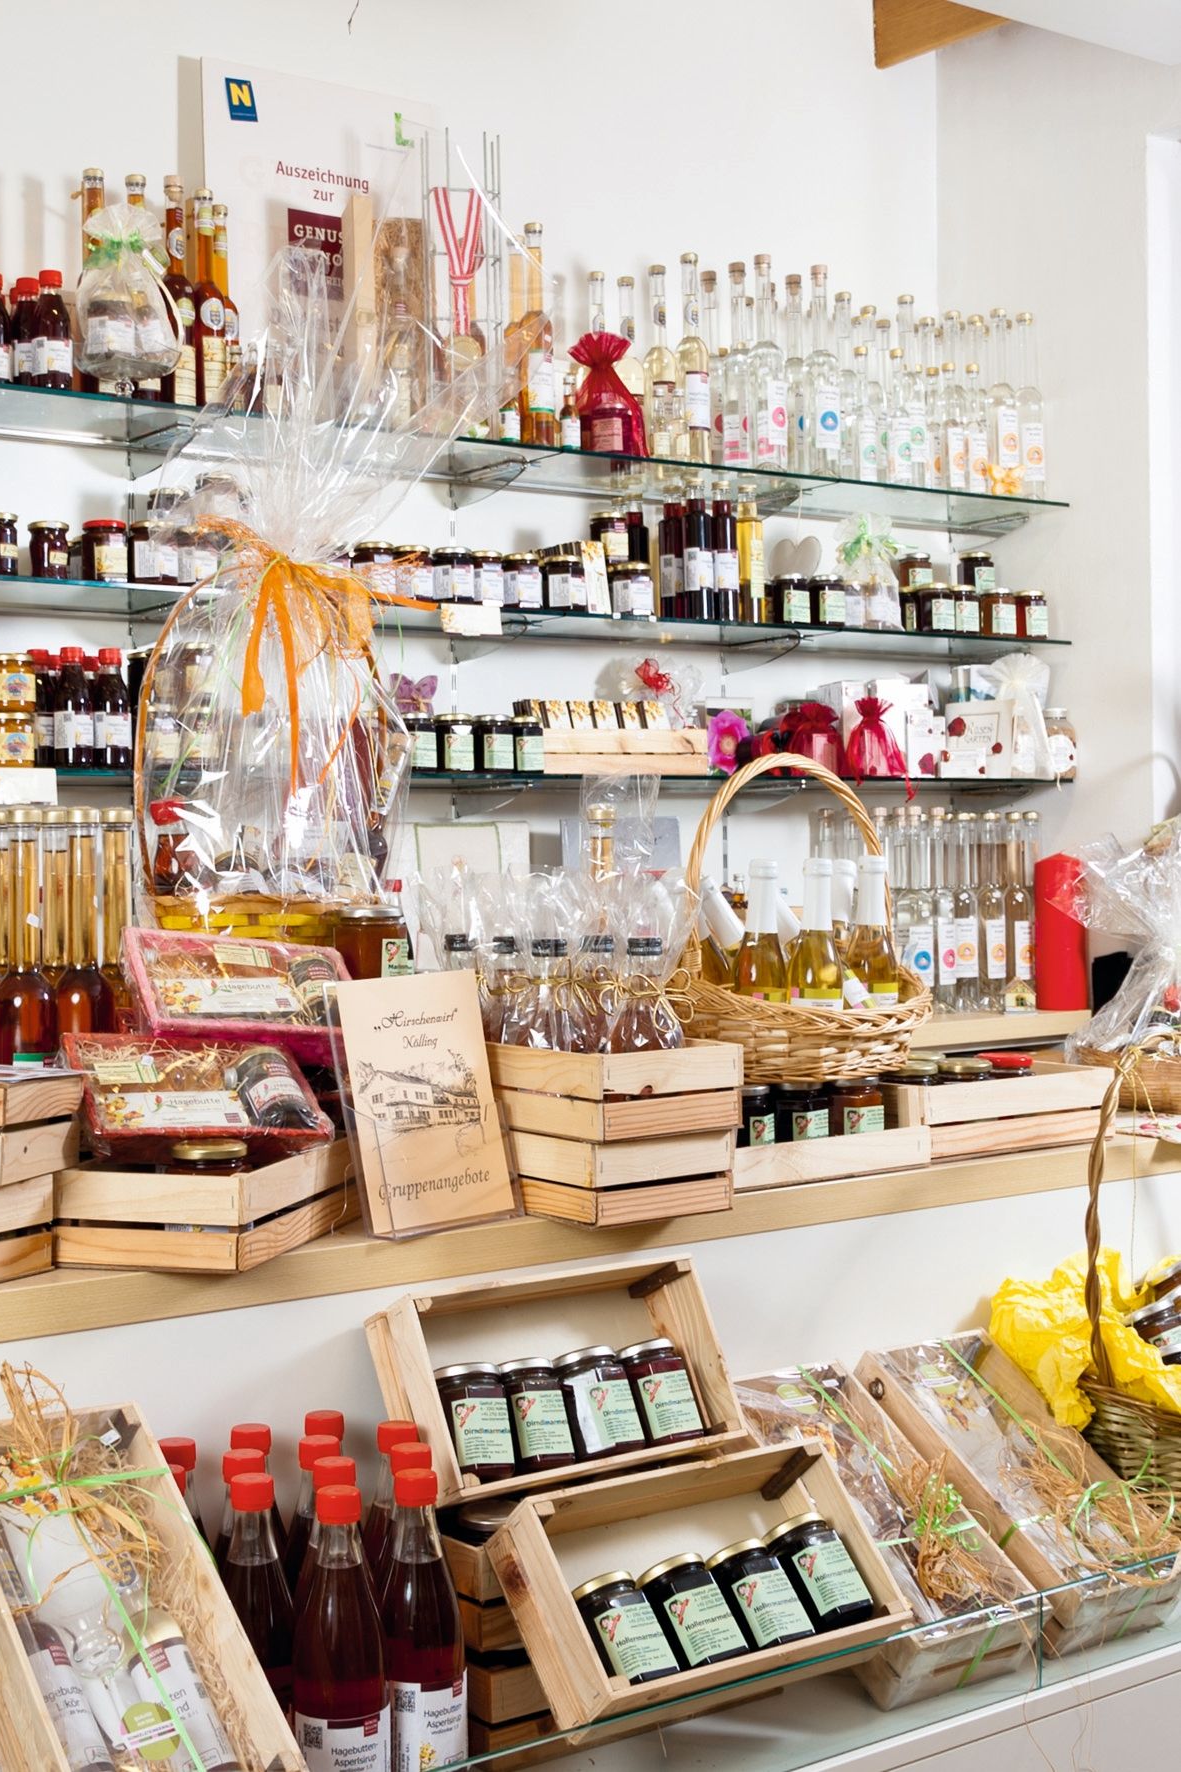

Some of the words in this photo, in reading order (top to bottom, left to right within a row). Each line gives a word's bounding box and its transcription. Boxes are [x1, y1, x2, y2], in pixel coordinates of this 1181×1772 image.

[275, 160, 370, 194] Auszeichnung
[312, 188, 335, 203] zur
[378, 1167, 491, 1206] Gruppenangebote
[330, 1741, 378, 1757] Hagebutten-
[333, 1753, 378, 1769] Asperlsirup
